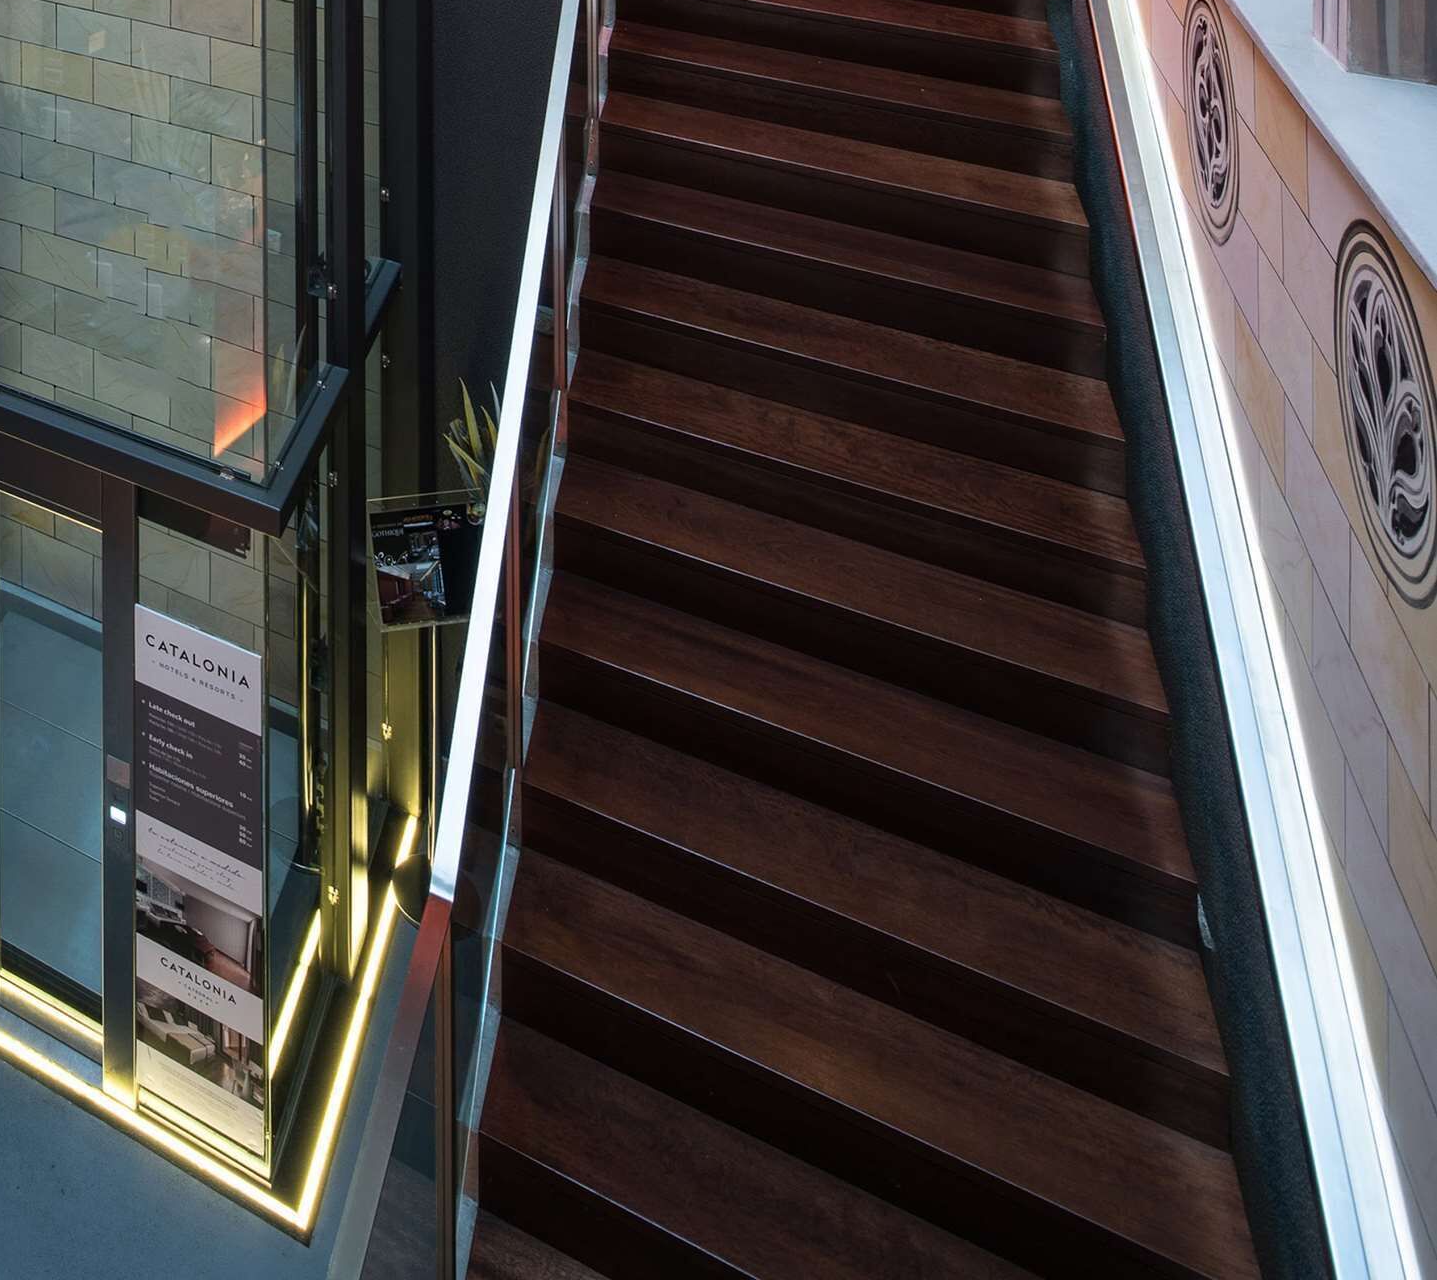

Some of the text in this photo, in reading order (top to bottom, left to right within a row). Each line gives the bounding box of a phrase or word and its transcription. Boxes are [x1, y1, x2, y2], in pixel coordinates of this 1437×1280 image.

[145, 634, 250, 689] CATALONIA
[158, 661, 189, 680] HOTELS
[199, 679, 236, 700] RESORTS
[164, 709, 182, 722] check
[166, 742, 185, 756] check
[160, 957, 237, 1005] CATALONIA
